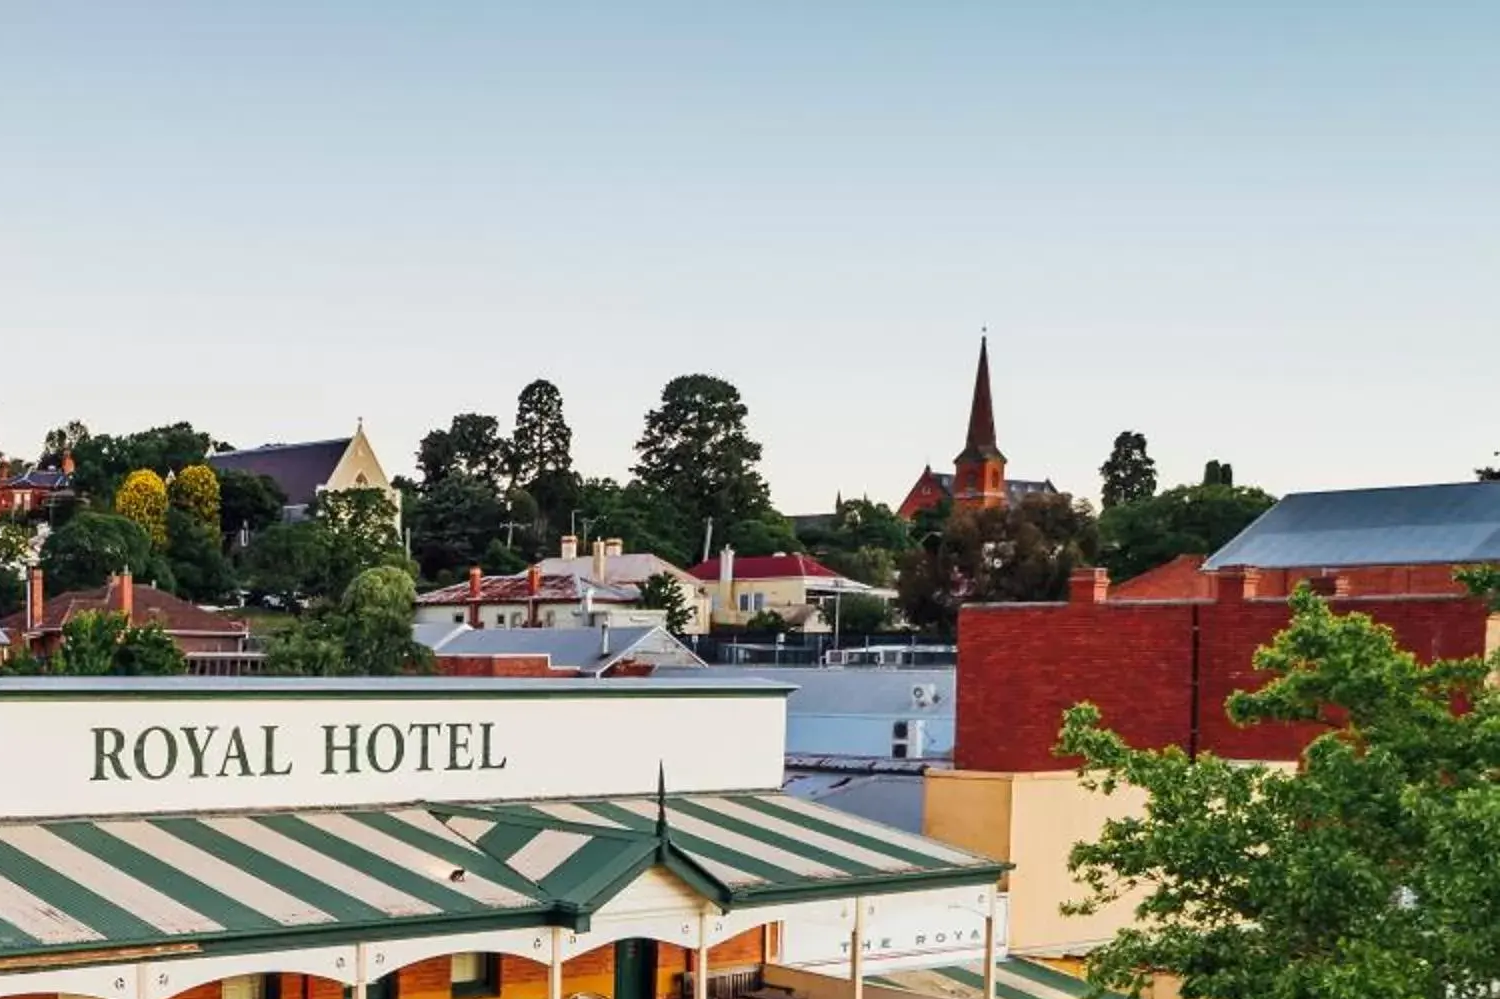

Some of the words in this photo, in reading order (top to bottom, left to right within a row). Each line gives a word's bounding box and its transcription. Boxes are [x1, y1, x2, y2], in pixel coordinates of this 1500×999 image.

[90, 724, 293, 781] ROYAL
[320, 721, 508, 776] HOTEL
[840, 937, 893, 953] THE
[915, 928, 981, 945] ROYA
